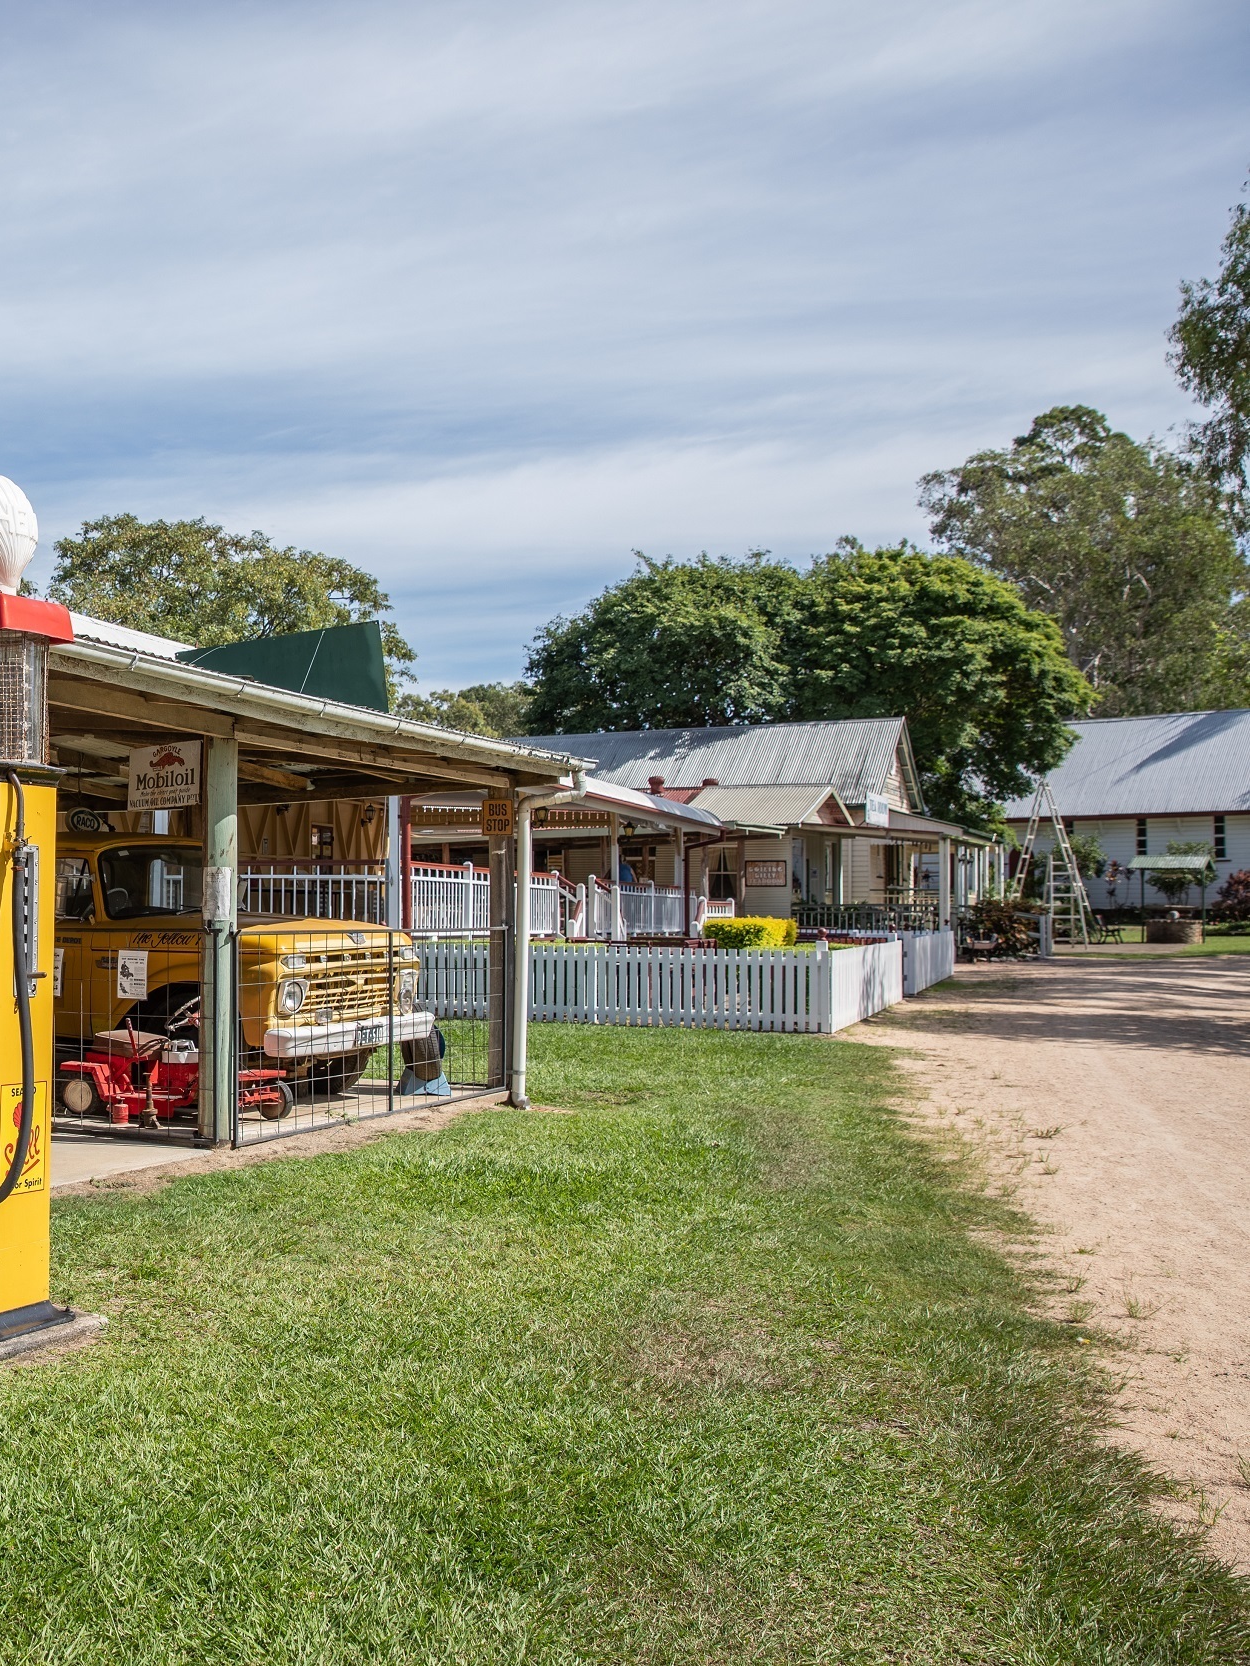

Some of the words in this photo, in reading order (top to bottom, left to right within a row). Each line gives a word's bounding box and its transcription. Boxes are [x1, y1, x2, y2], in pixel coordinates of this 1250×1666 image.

[152, 745, 182, 758] GARGOYLE
[135, 767, 196, 791] Mobiloil
[160, 795, 186, 806] COMPANY
[488, 803, 508, 816] BUS
[76, 815, 96, 829] RACQ
[486, 818, 510, 832] STOP
[11, 1086, 37, 1097] SEAD
[4, 1125, 40, 1177] Sll
[24, 1177, 42, 1189] Spirit
